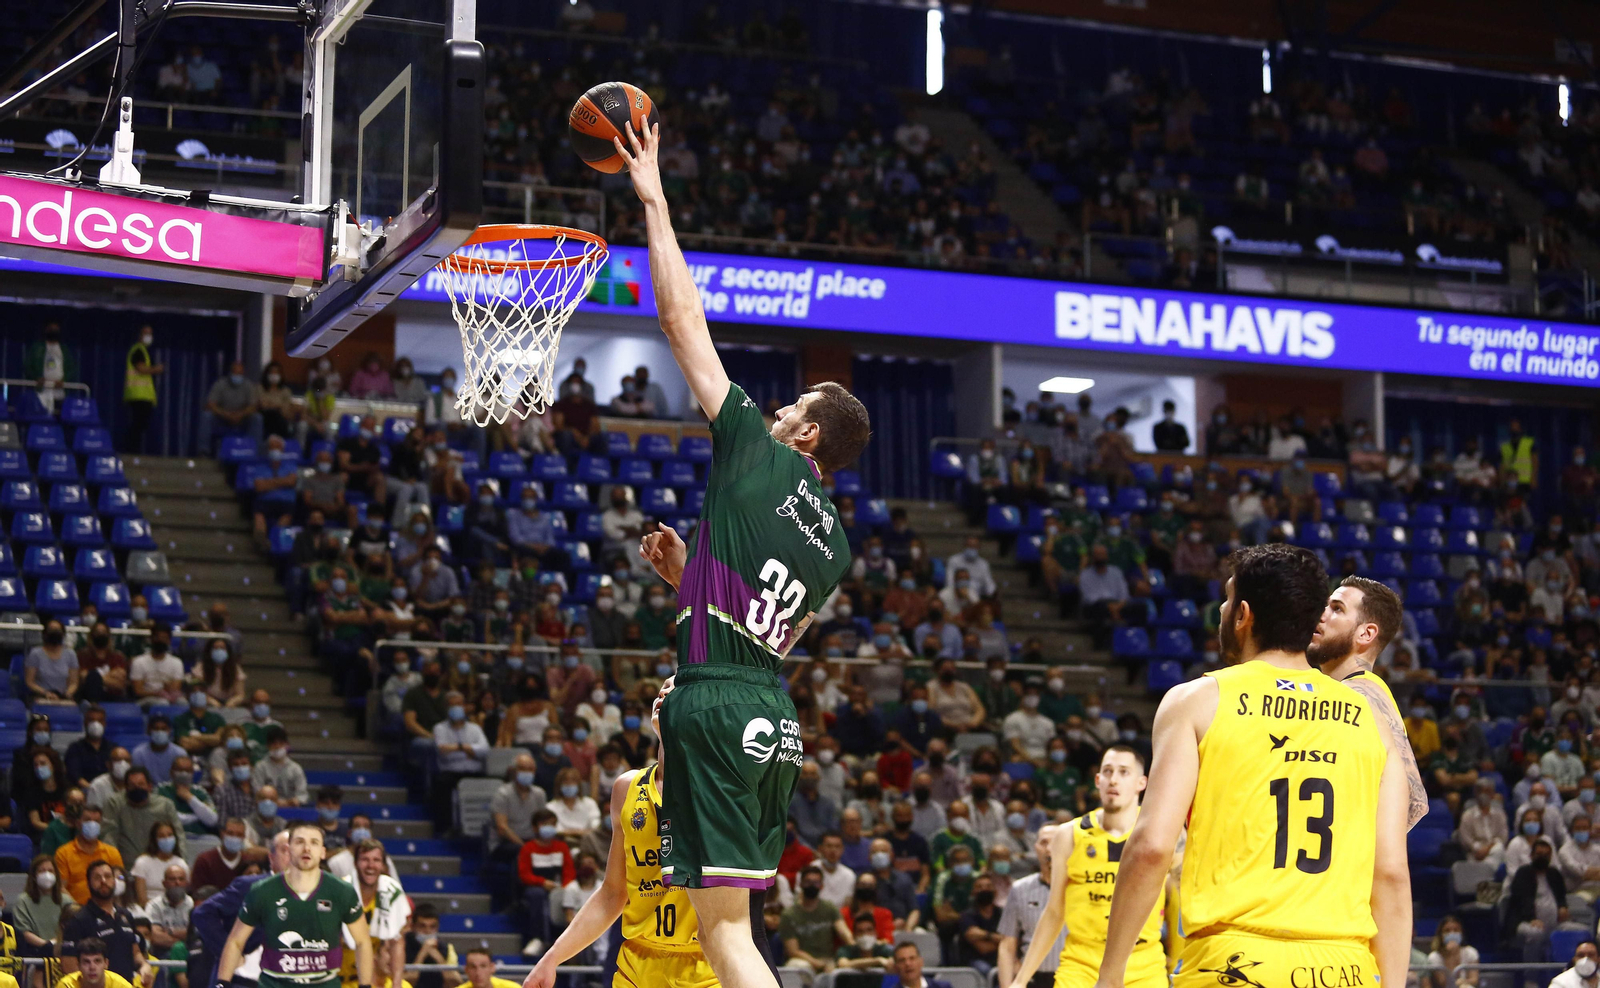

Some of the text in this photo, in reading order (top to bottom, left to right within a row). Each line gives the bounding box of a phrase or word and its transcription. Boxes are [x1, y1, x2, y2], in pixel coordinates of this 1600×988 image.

[721, 267, 814, 293] second
[816, 269, 887, 299] place
[734, 292, 810, 318] world
[1054, 290, 1336, 360] BENAHAVIS
[1416, 316, 1600, 358] Tu segundo lugar
[1469, 350, 1600, 380] en el mundo
[745, 557, 807, 651] 32
[1237, 692, 1362, 727] S. RODRÍGUEZ
[781, 736, 798, 750] DEL
[1269, 777, 1334, 874] 13
[654, 903, 676, 938] 10
[1290, 964, 1364, 988] CICAR
